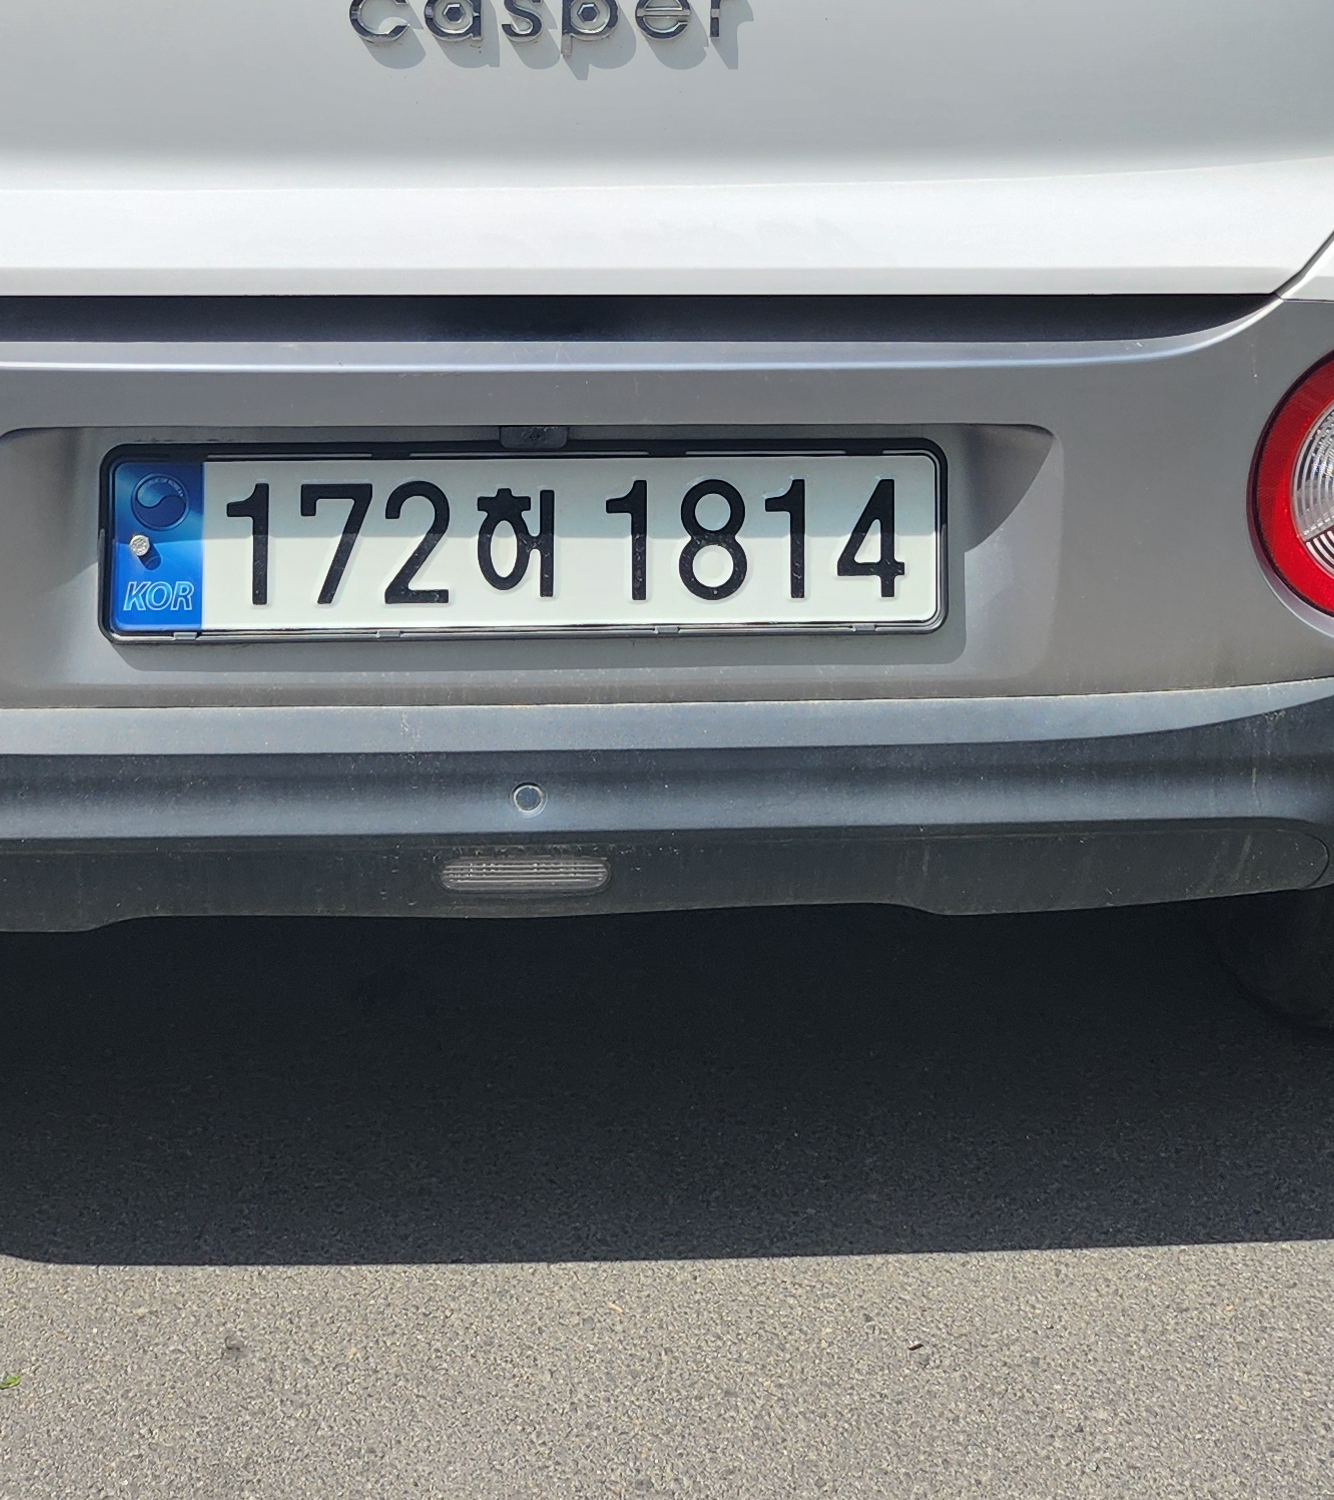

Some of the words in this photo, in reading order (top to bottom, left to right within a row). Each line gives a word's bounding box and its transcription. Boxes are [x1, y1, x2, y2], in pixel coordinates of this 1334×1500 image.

[226, 480, 555, 606] 172허
[605, 478, 906, 601] 1814
[123, 580, 195, 611] KOR
